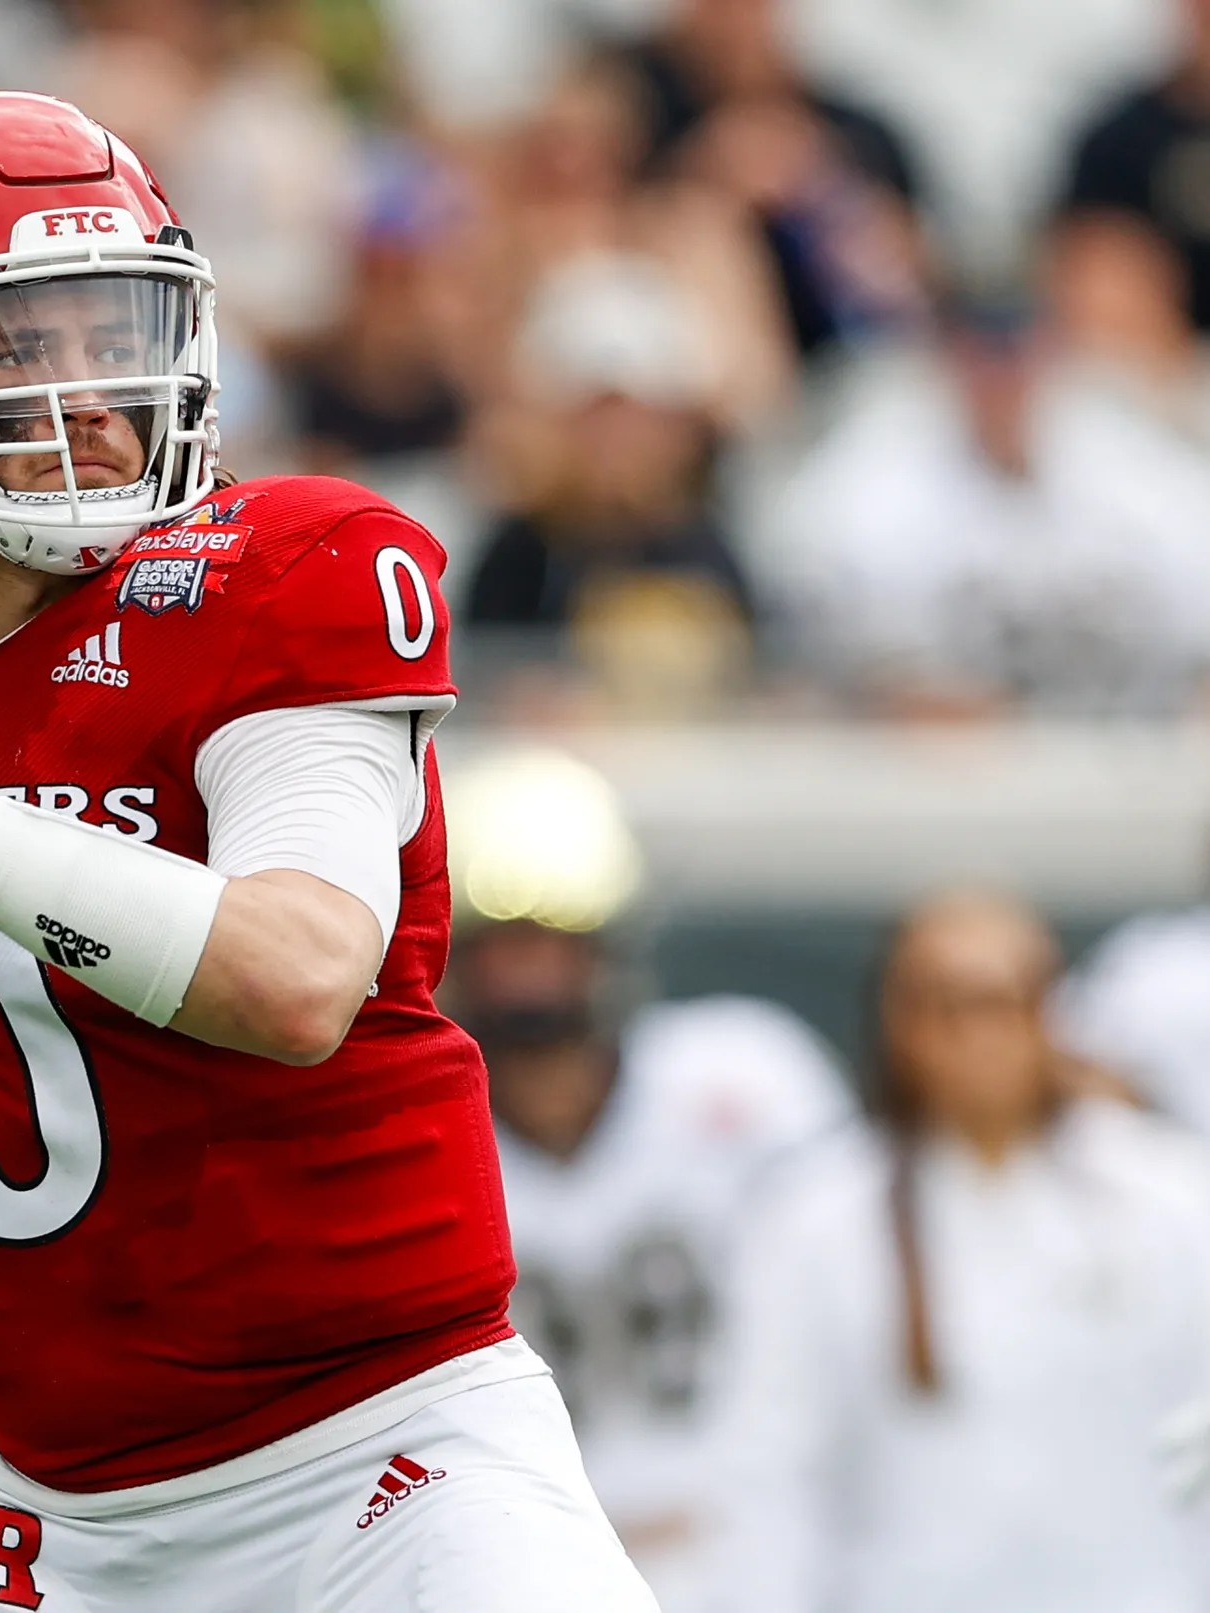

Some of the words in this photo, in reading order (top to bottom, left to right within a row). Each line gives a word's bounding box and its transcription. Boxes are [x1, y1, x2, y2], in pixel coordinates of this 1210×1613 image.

[42, 211, 119, 236] F.T.C.
[130, 527, 239, 554] TaxSlayer
[131, 571, 194, 589] BOWL
[137, 559, 196, 576] GATOR
[375, 545, 435, 661] 0
[51, 659, 130, 688] adidas
[35, 913, 111, 960] adidas
[356, 1467, 447, 1529] adidas
